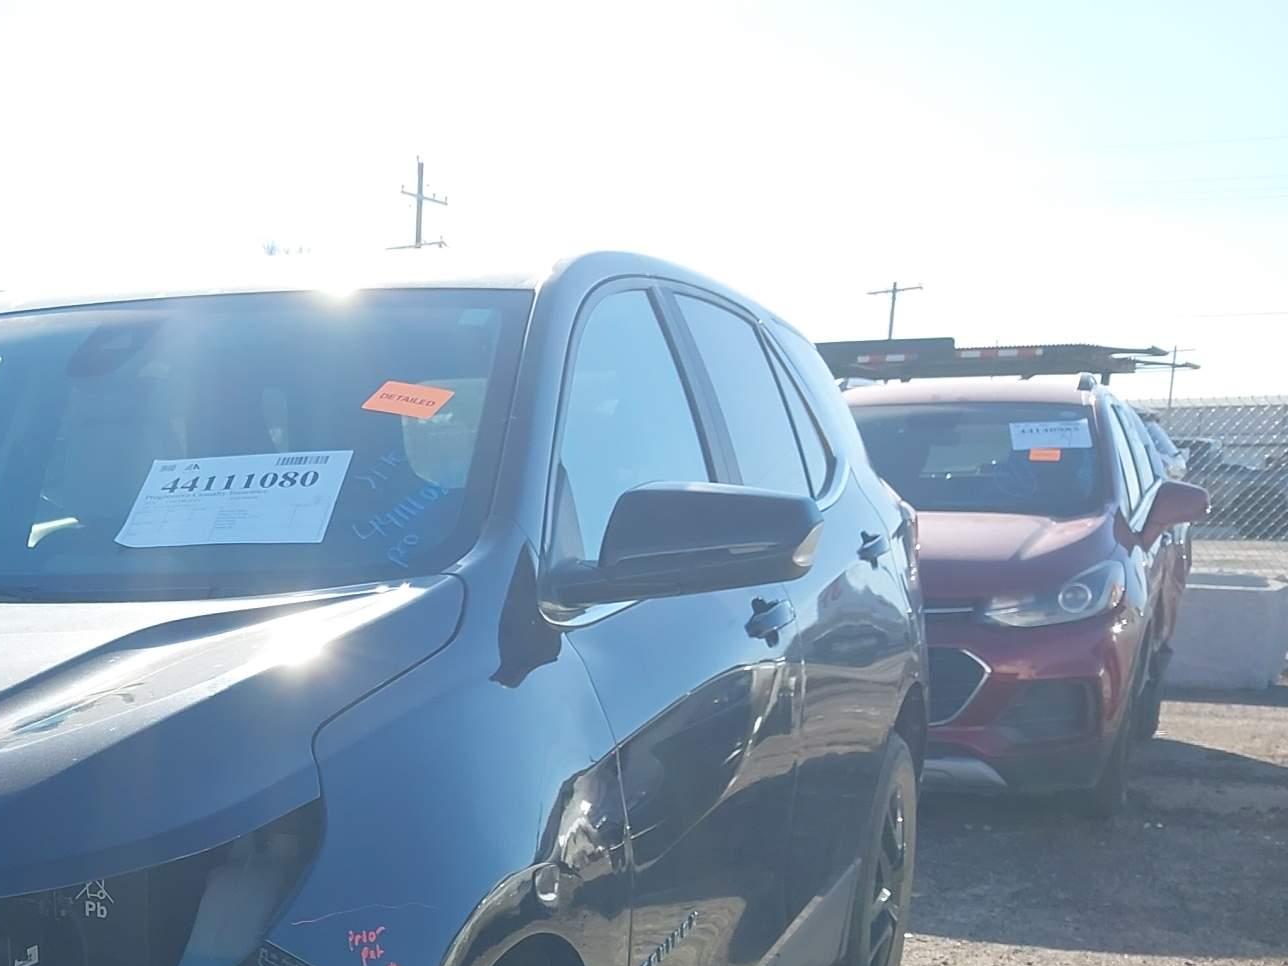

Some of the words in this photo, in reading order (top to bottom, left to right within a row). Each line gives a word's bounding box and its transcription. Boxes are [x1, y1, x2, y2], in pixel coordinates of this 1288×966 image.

[379, 392, 436, 407] DETAILED
[160, 470, 320, 494] 44111080
[85, 900, 108, 919] Pb
